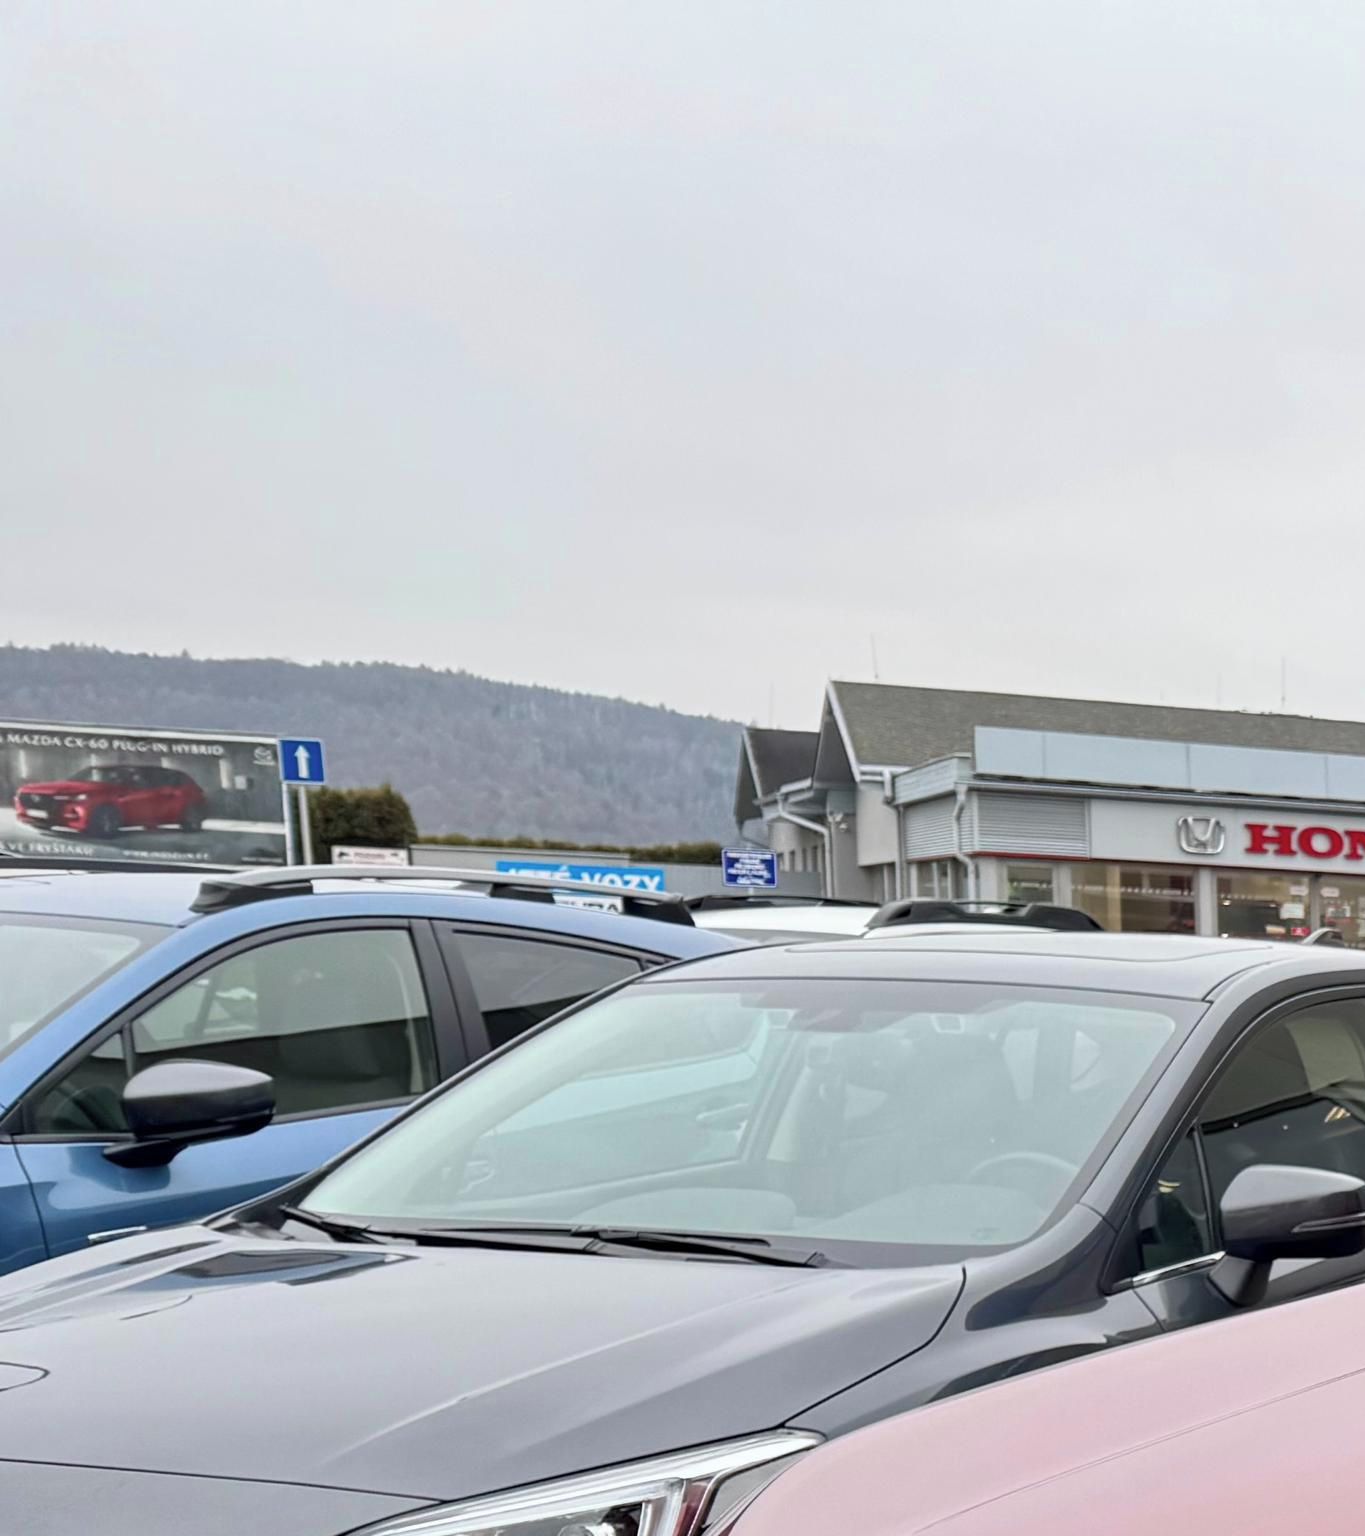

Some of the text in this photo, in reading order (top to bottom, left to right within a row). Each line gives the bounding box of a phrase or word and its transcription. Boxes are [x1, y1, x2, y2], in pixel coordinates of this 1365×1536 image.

[7, 733, 62, 747] MAZDA
[63, 736, 109, 750] CX-60
[171, 743, 225, 756] HYBRID
